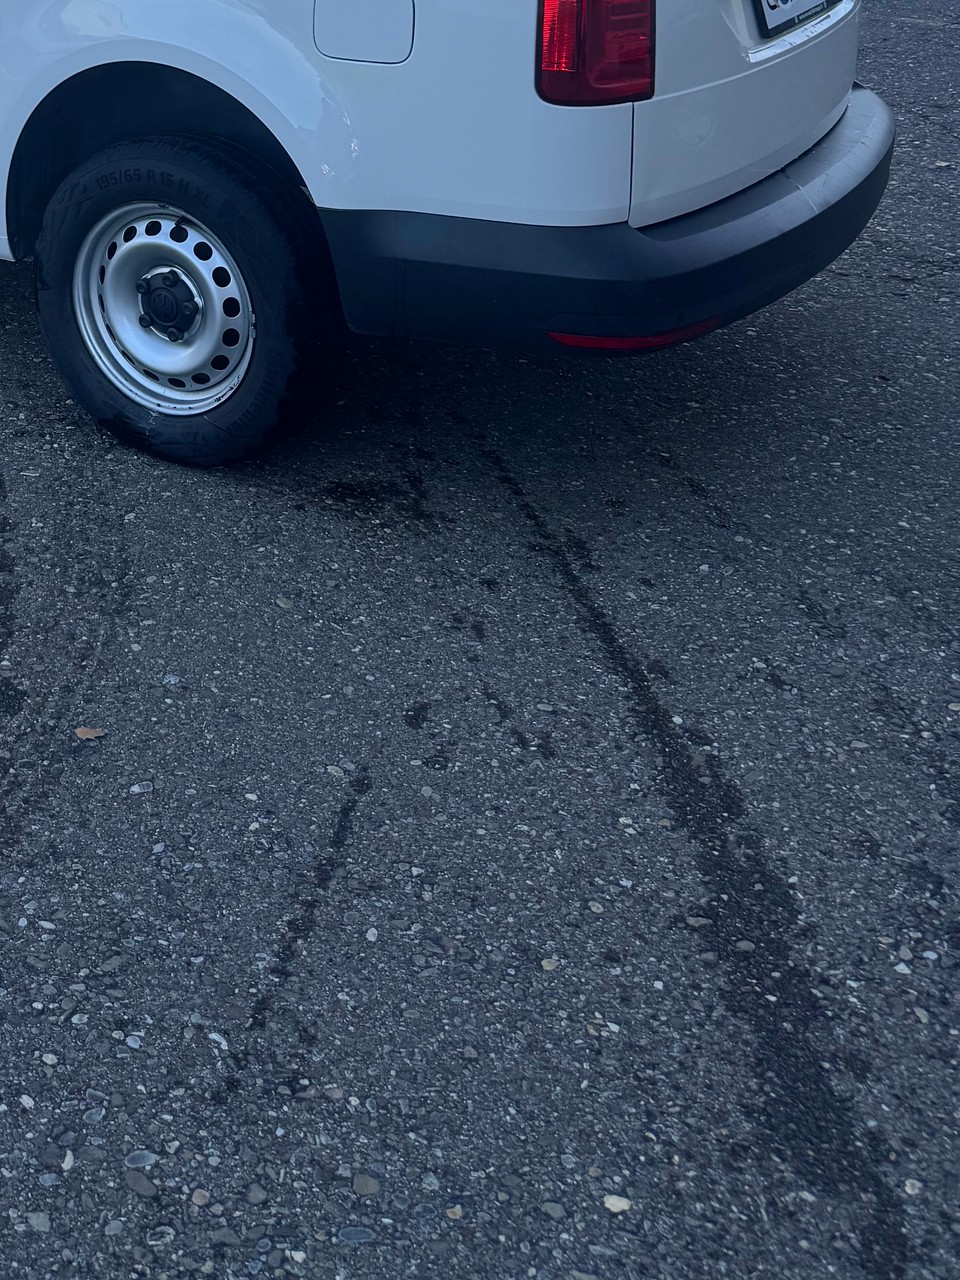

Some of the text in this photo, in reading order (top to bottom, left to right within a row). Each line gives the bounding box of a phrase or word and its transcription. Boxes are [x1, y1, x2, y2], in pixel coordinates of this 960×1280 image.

[96, 168, 141, 191] 195/65
[147, 168, 157, 184] R
[159, 171, 174, 187] 15
